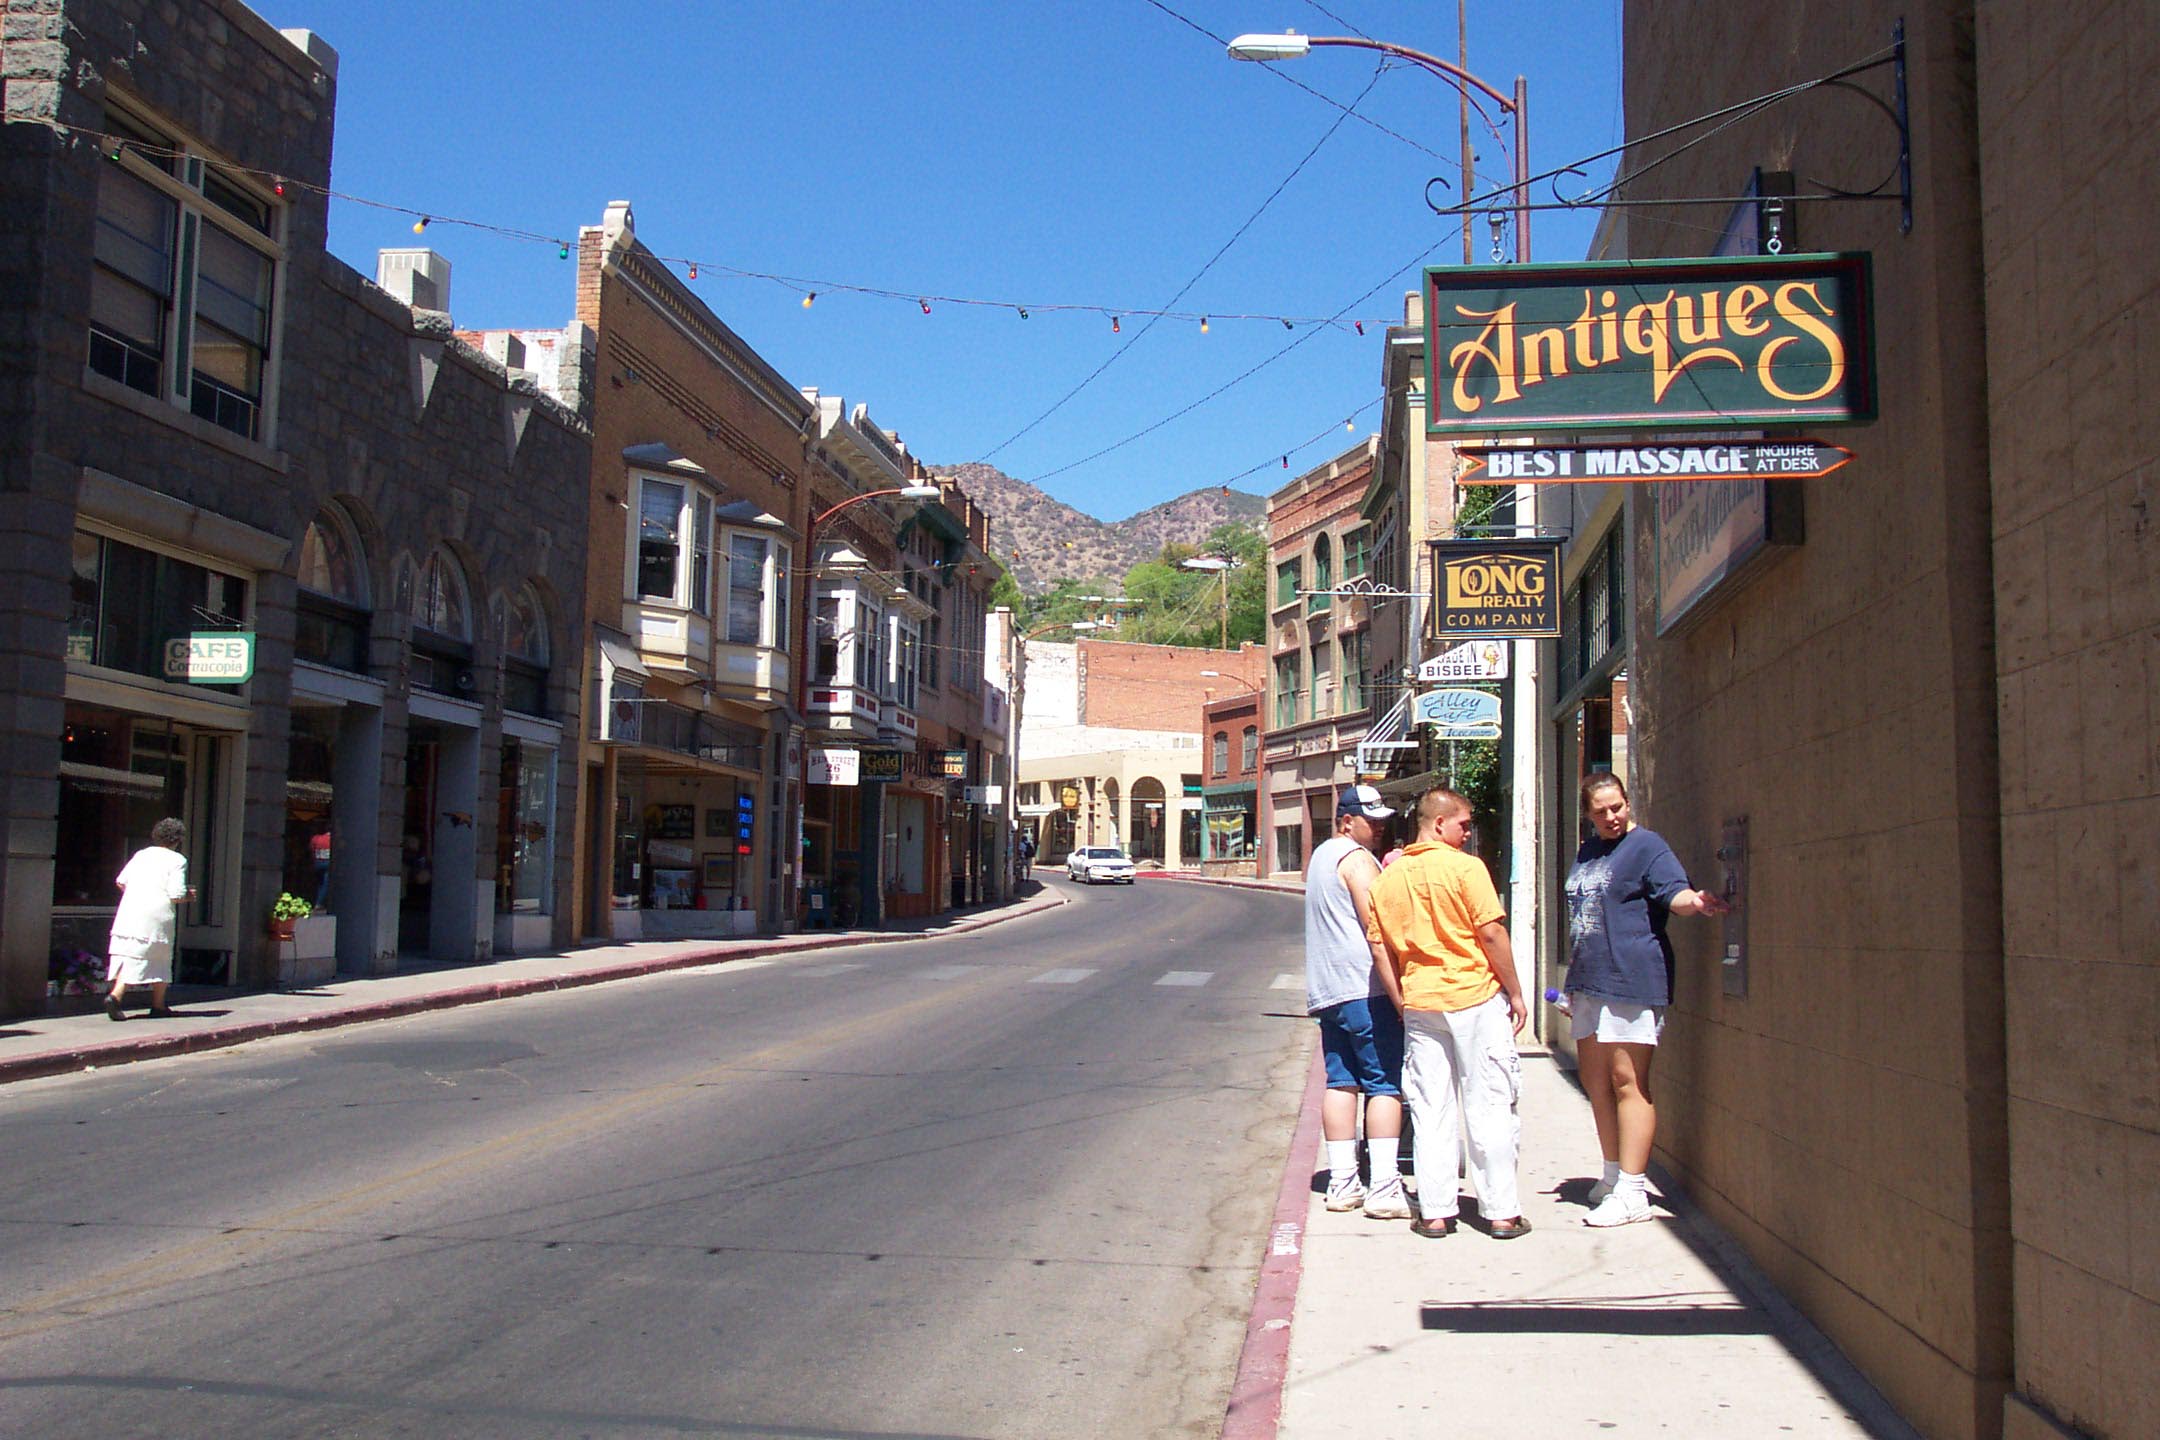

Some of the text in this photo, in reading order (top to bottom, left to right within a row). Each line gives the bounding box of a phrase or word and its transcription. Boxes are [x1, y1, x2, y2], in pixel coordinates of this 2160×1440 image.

[1449, 282, 1845, 413] Antiques
[1756, 445, 1815, 458] INQUIRE
[1488, 445, 1749, 478] BEST MASSAGE
[1756, 457, 1820, 472] AT DESK
[1445, 564, 1545, 608] LONG
[1483, 595, 1545, 608] REALTY
[1446, 613, 1546, 626] COMPANY
[170, 642, 242, 658] CAFE
[168, 659, 242, 674] Cornucopia
[1426, 665, 1482, 677] BISBEE
[863, 754, 899, 772] Gold
